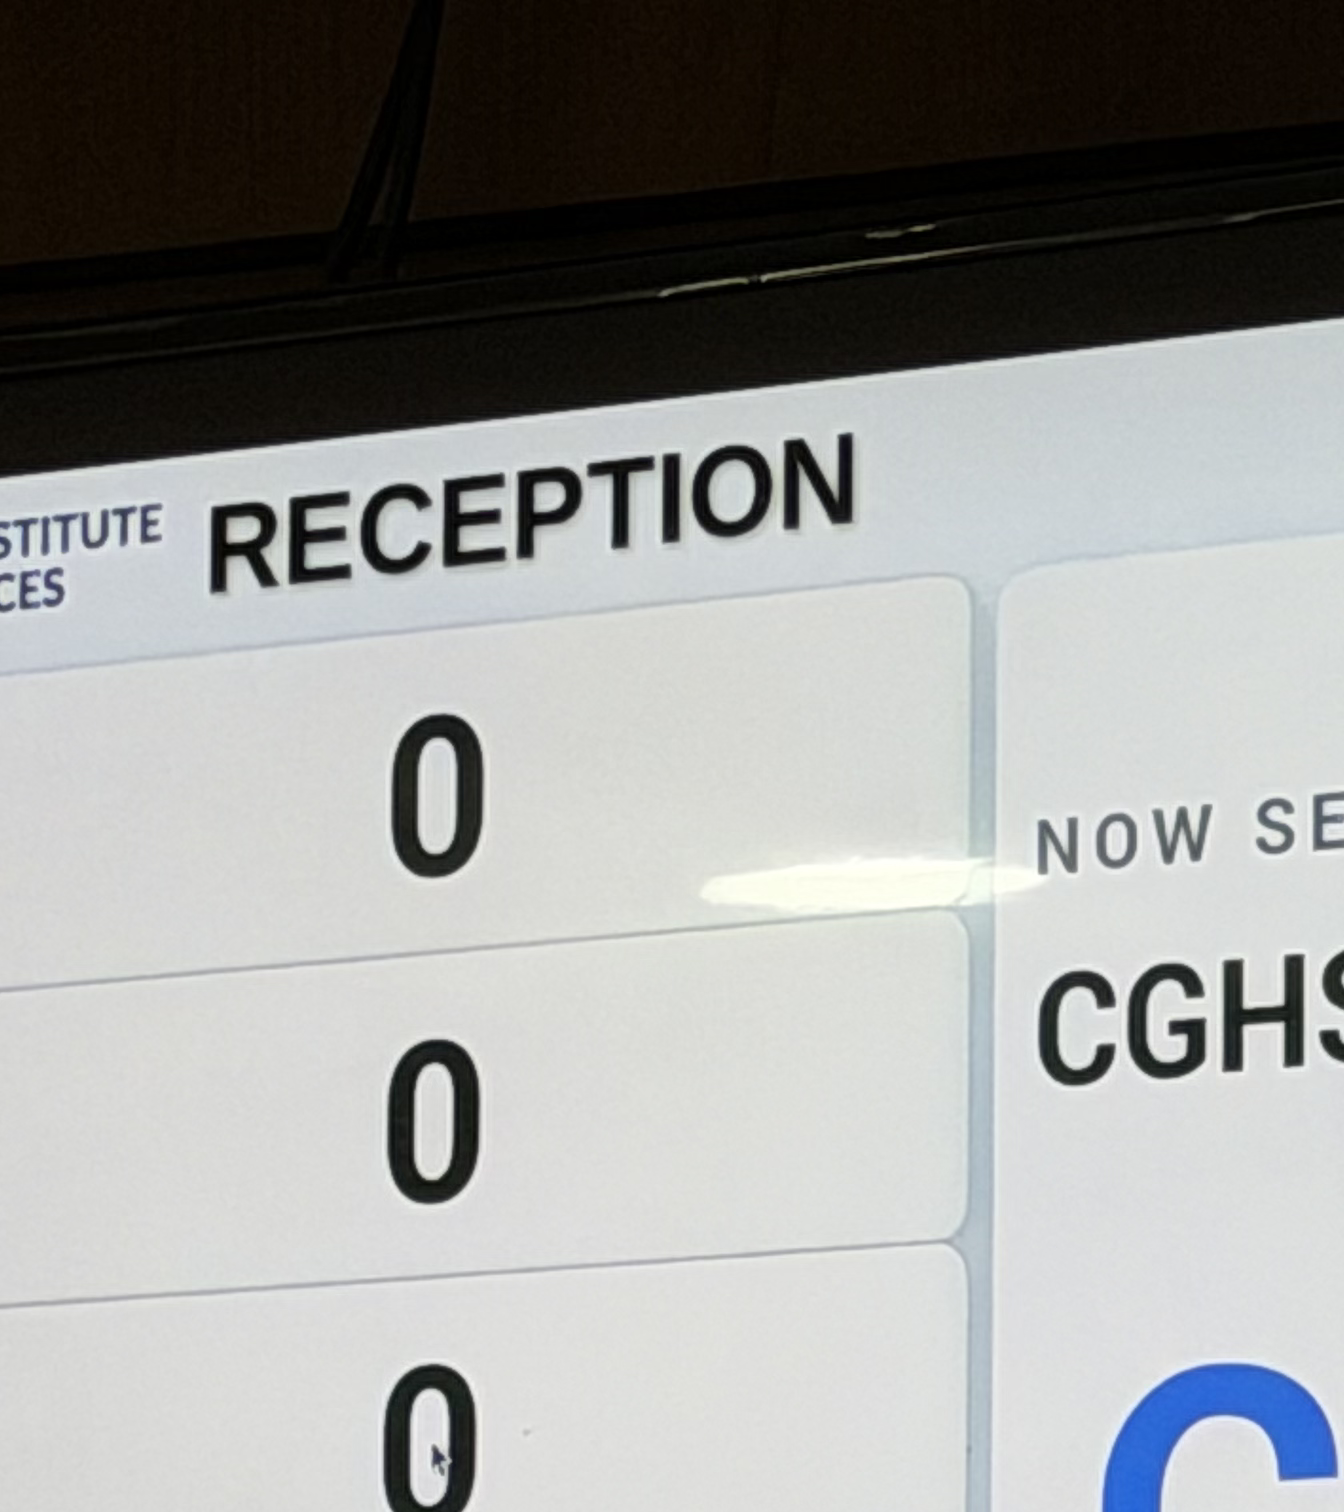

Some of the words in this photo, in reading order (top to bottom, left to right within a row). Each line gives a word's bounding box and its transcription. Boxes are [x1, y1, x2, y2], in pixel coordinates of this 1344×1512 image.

[210, 432, 854, 594] RECEPTION
[391, 713, 484, 879] 0
[1037, 804, 1213, 875] NOW
[387, 1039, 481, 1205] 0
